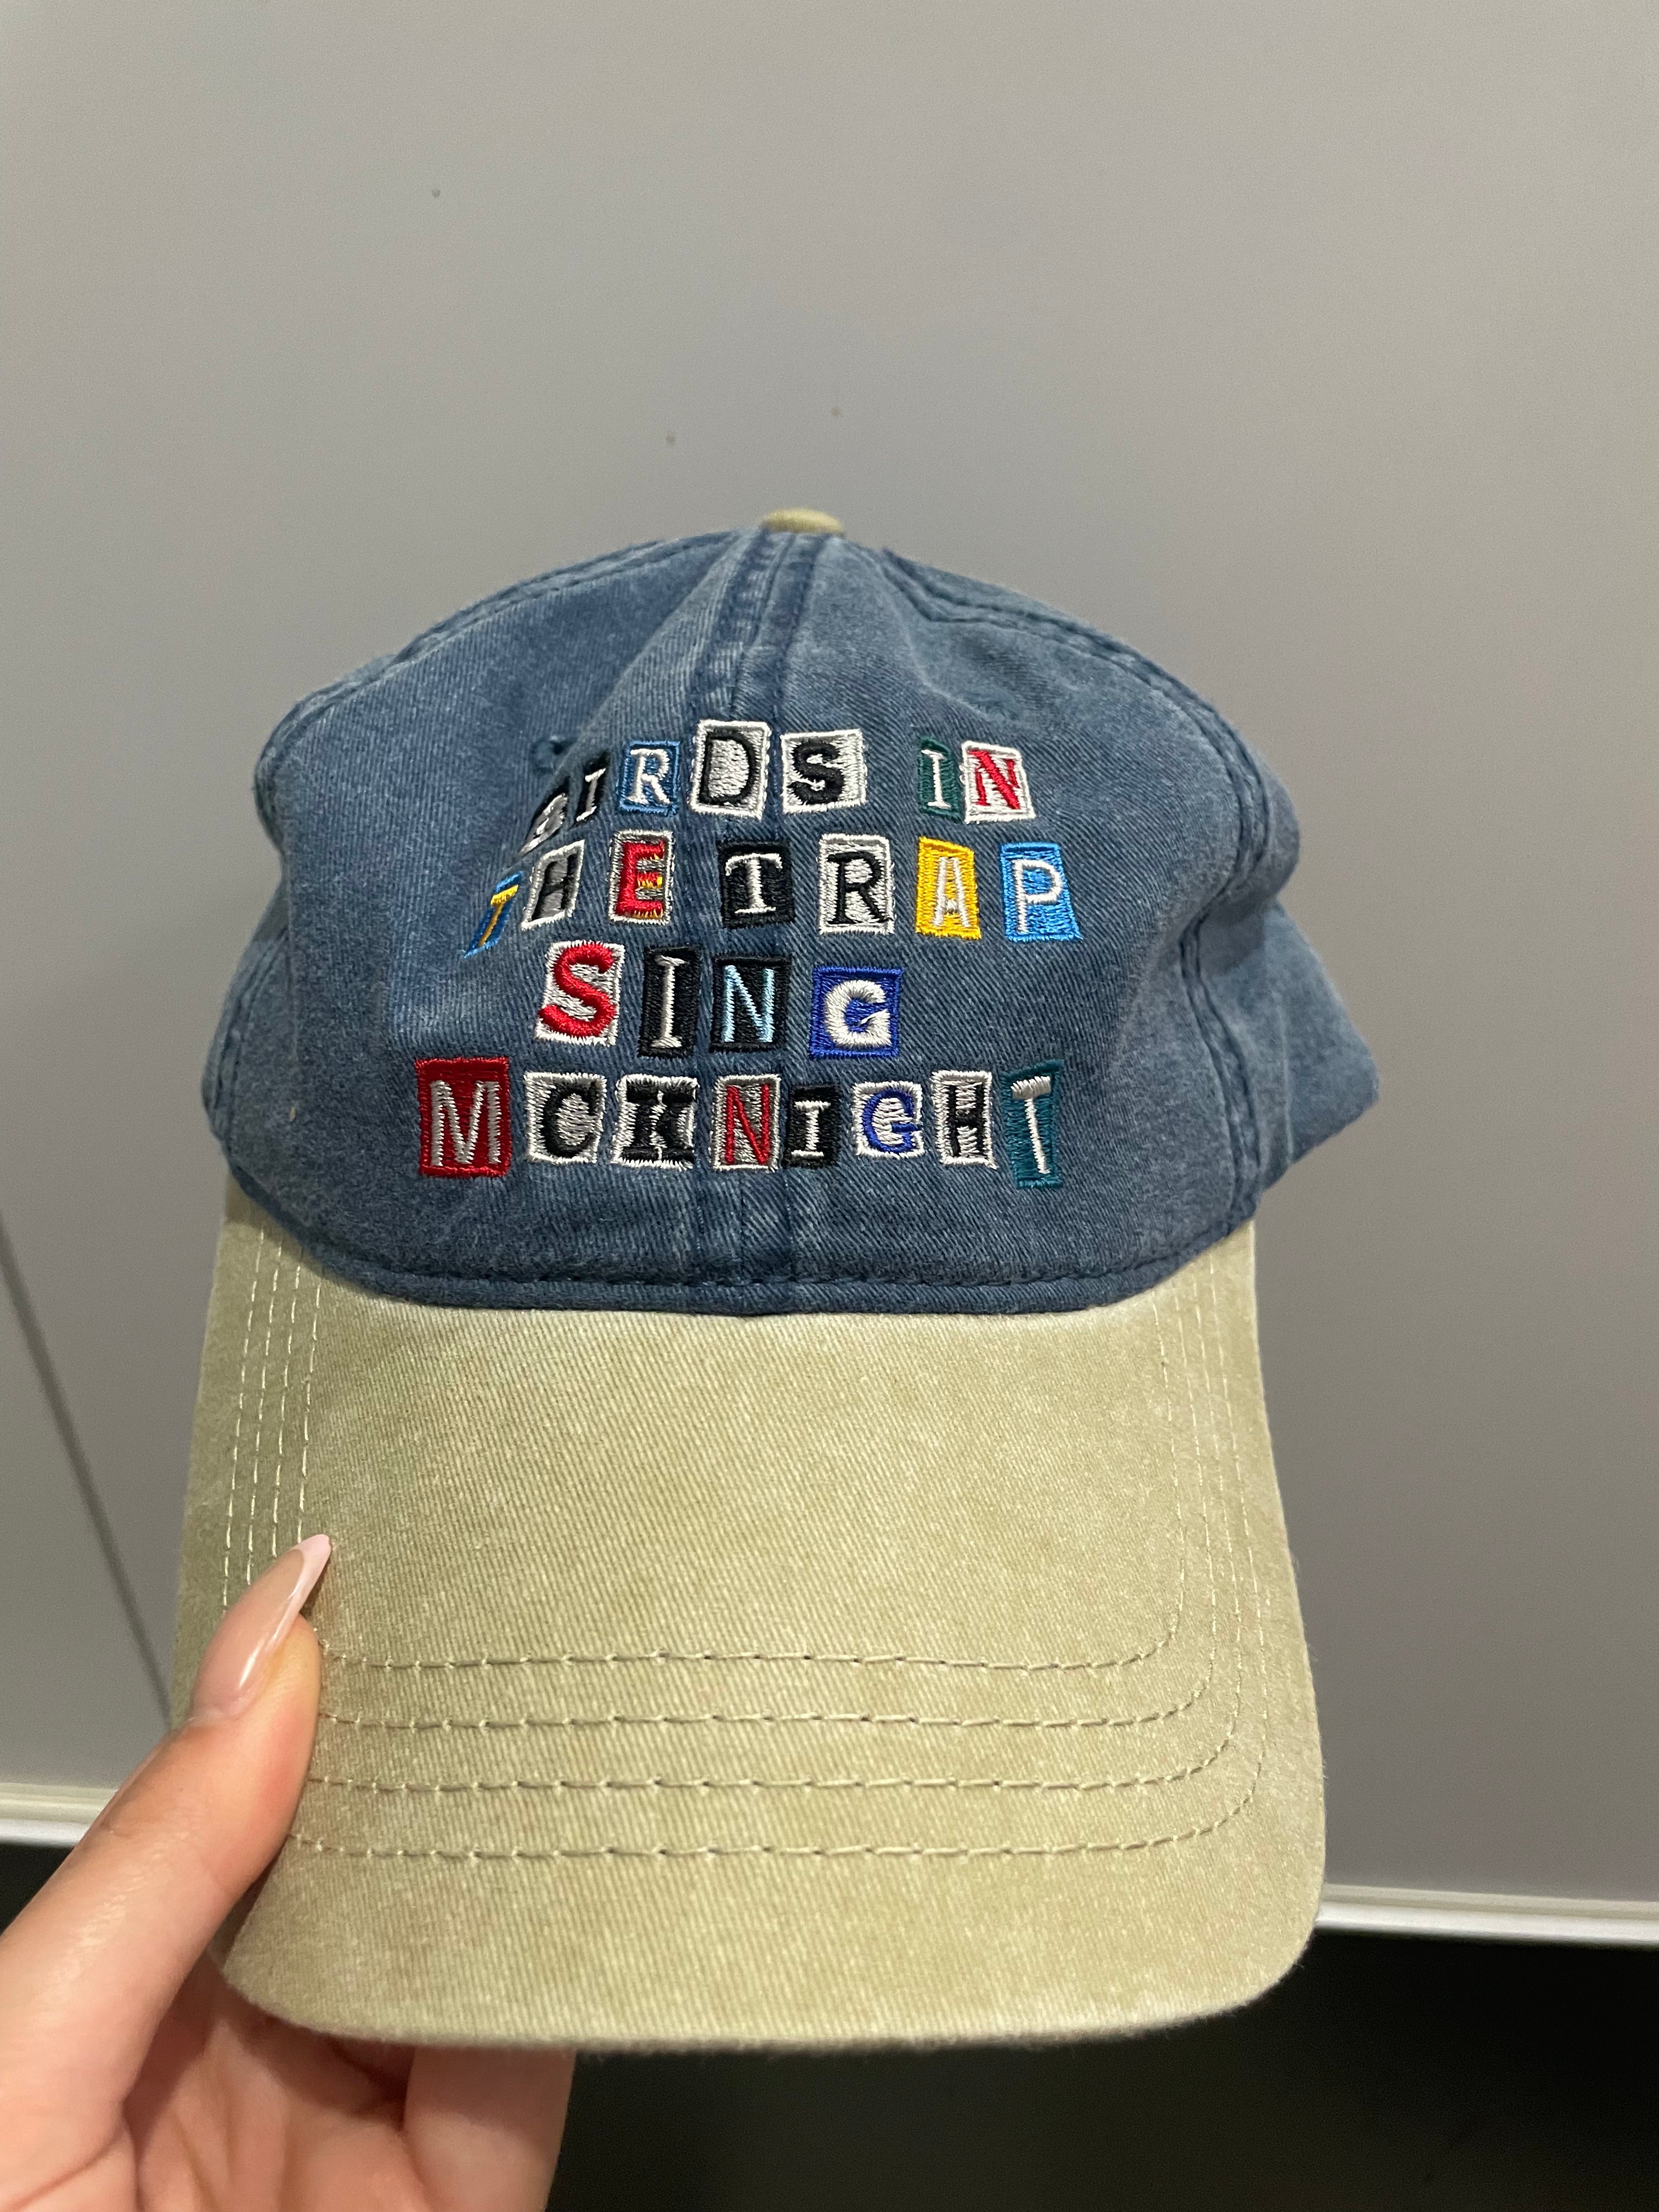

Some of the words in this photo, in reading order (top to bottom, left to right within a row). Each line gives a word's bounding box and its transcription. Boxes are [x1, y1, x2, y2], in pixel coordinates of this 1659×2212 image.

[920, 745, 1025, 814] IN
[476, 838, 665, 950] THE
[725, 850, 1064, 934] TRAP
[538, 942, 891, 1048] SING
[429, 1075, 1052, 1175] MCKNIGHT
